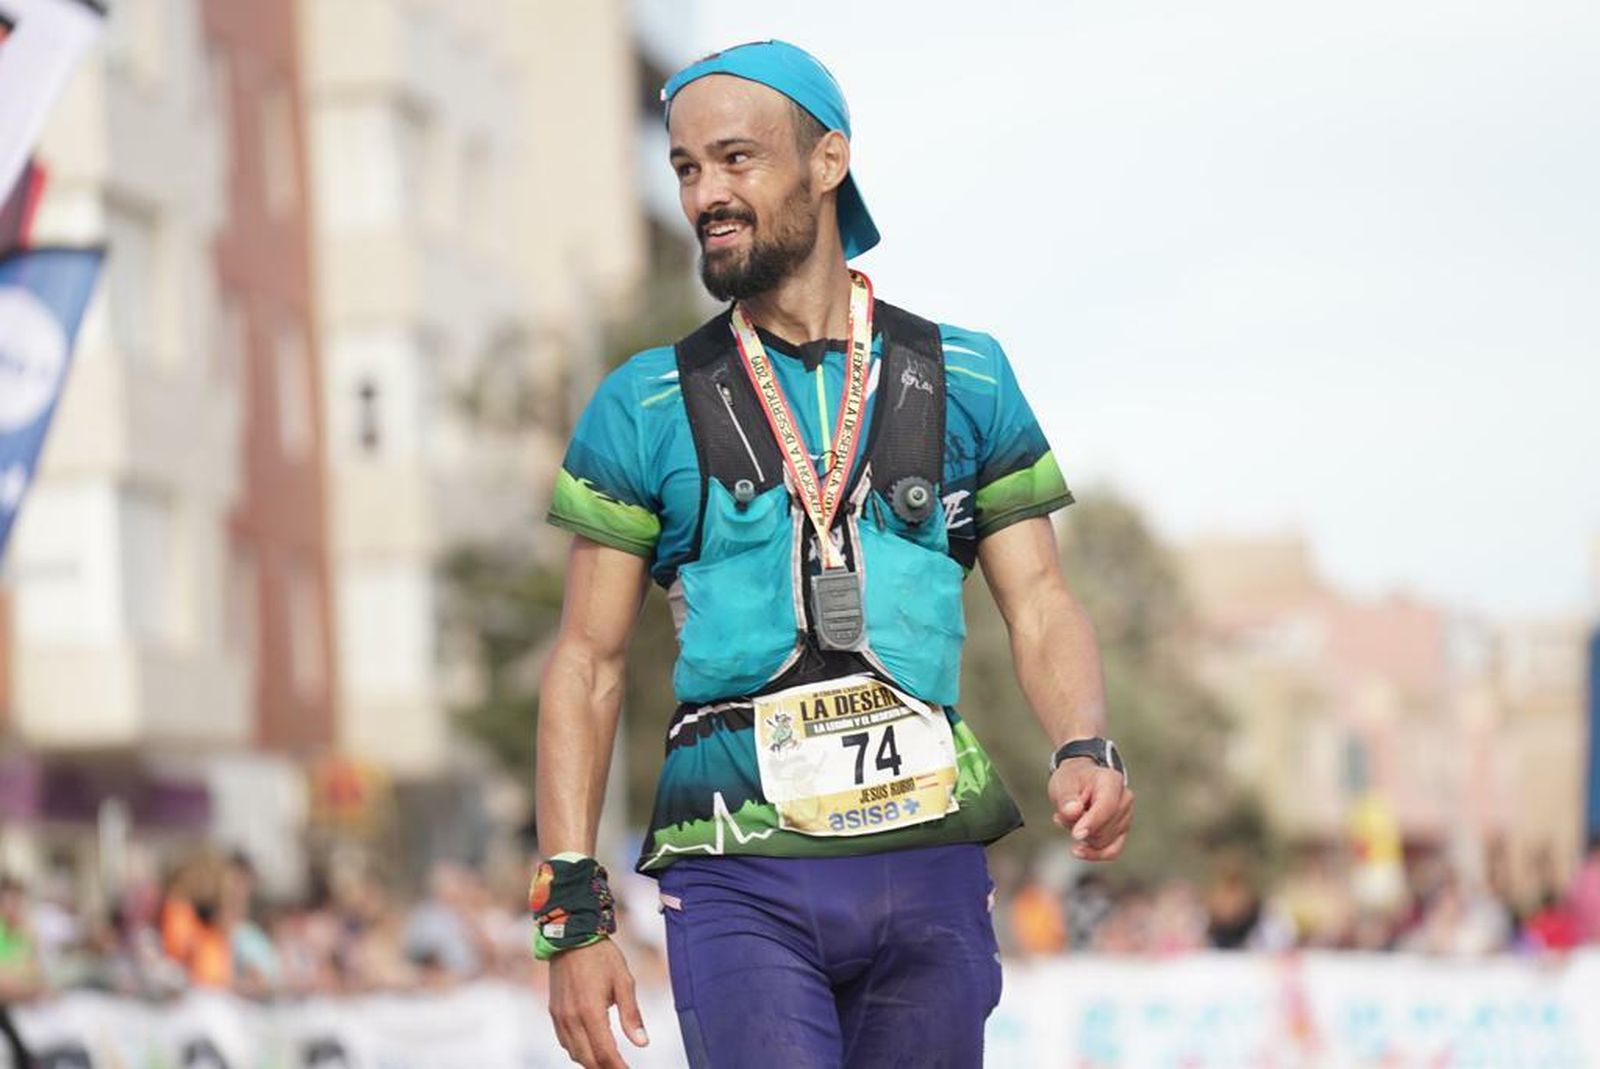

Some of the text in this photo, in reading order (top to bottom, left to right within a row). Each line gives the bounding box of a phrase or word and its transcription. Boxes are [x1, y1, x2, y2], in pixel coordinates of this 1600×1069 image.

[847, 398, 860, 416] LA
[789, 446, 804, 465] LA
[800, 698, 829, 722] LA
[842, 725, 902, 785] 74
[828, 801, 900, 831] asisa
